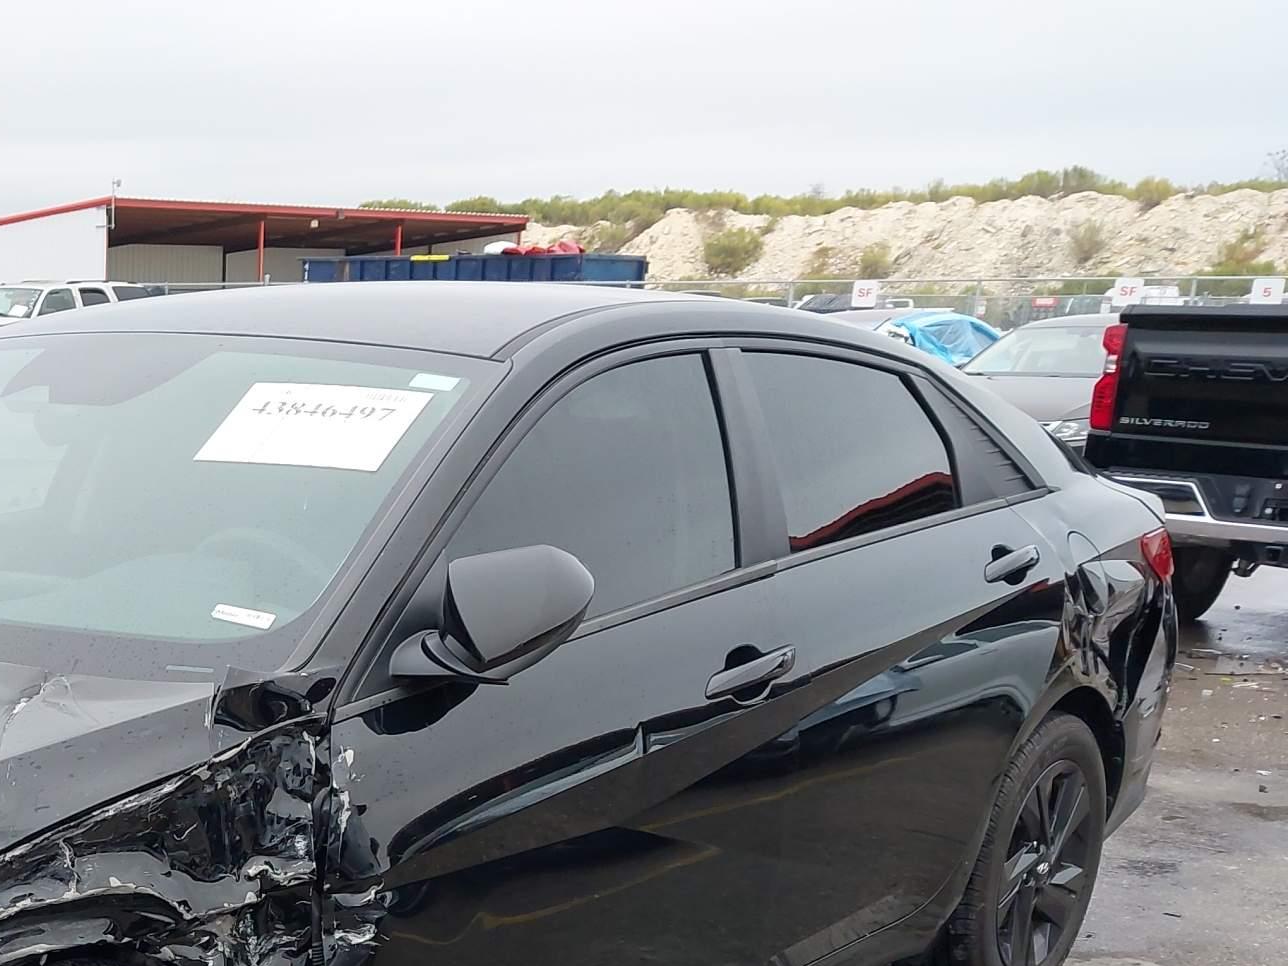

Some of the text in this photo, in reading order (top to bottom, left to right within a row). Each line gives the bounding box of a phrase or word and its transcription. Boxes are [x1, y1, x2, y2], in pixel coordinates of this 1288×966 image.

[857, 287, 873, 298] SF
[1119, 286, 1138, 297] SF
[251, 400, 397, 421] 43846497
[1119, 416, 1211, 430] SILVERADO
